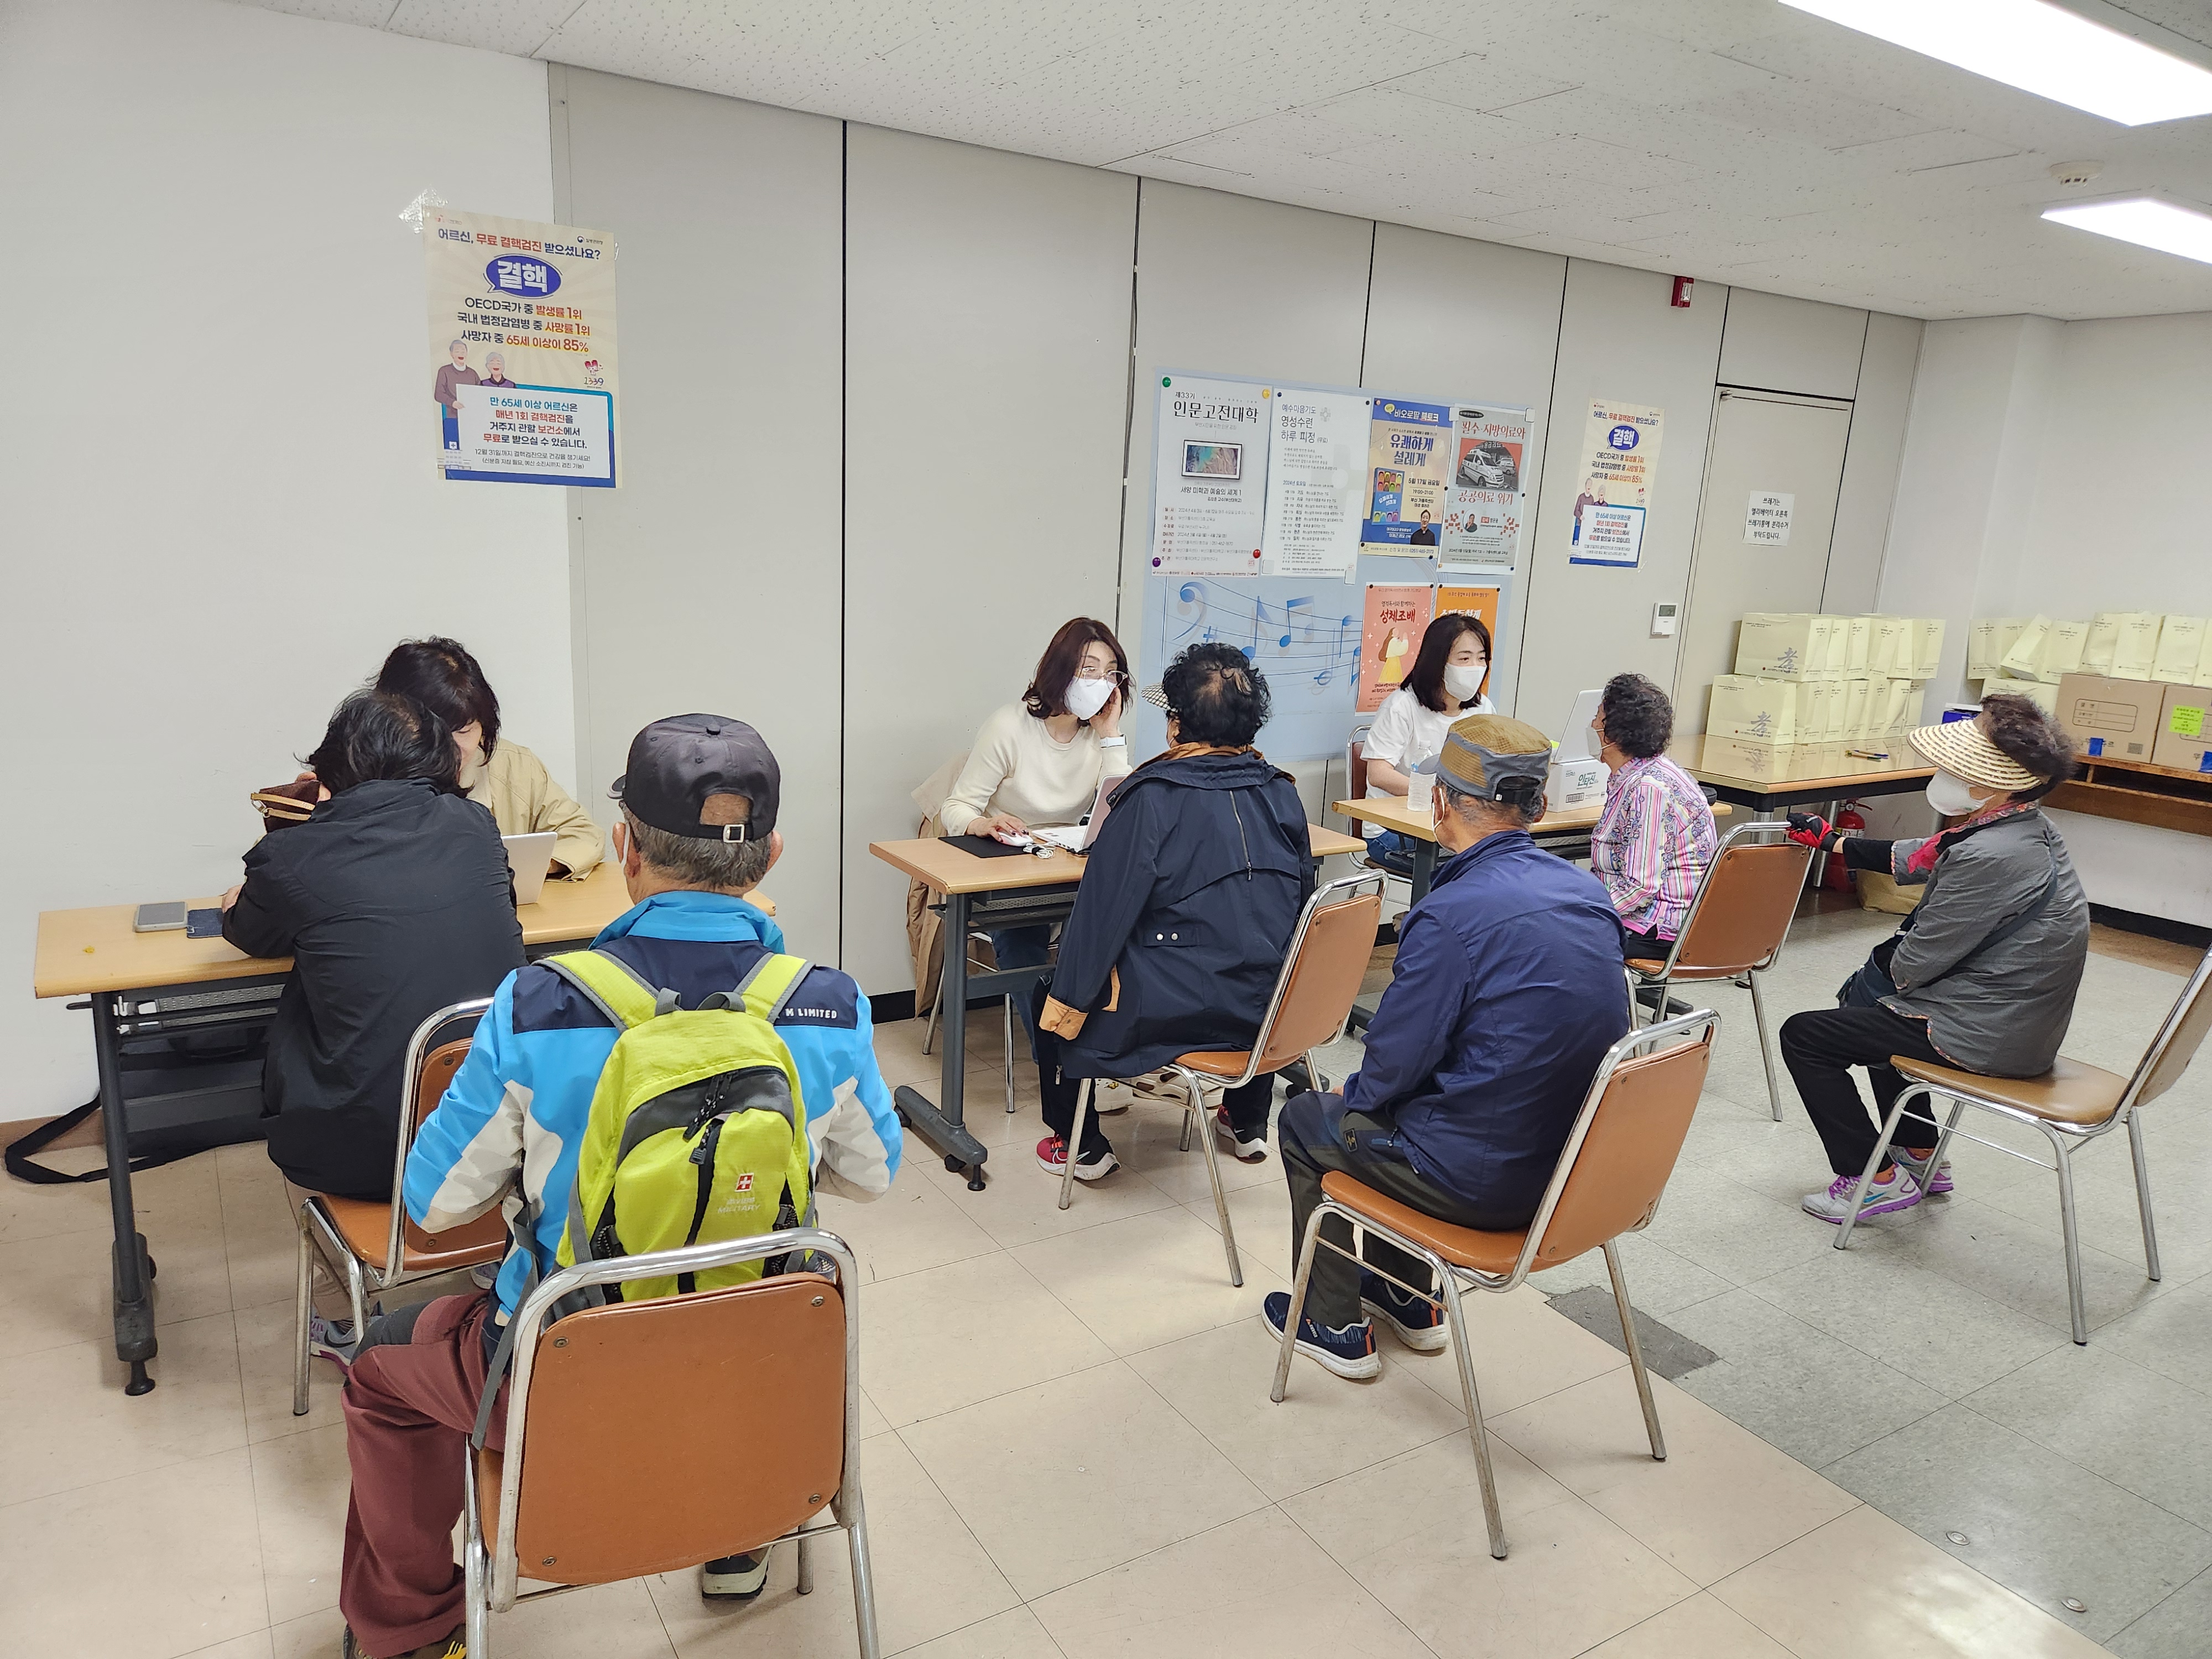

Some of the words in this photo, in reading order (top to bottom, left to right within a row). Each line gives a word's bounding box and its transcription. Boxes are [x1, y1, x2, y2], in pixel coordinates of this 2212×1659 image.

[439, 228, 473, 244] 어르신,
[476, 233, 498, 246] 무료
[500, 236, 541, 252] 결핵검진
[545, 242, 601, 260] 받으셨나요?
[498, 260, 547, 293] 결핵
[465, 298, 521, 313] OECD국가
[524, 304, 534, 315] 중
[536, 305, 565, 318] 발생률
[567, 307, 582, 320] 1위
[457, 312, 478, 324] 국내
[481, 315, 530, 330] 법정감염병
[533, 320, 542, 331] 중
[545, 322, 573, 334] 사망률
[575, 323, 590, 336] 1위
[461, 330, 492, 342] 사망자
[494, 333, 504, 343] 중
[507, 335, 529, 346] 65세
[533, 337, 561, 349] 이상이
[564, 338, 589, 352] 85%
[584, 377, 604, 386] 1339
[490, 397, 499, 406] 만
[501, 398, 522, 408] 65세
[524, 400, 541, 409] 이상
[544, 401, 578, 412] 어르신은
[1282, 404, 1316, 414] 예수마음기도
[495, 410, 513, 419] 매년
[515, 411, 528, 420] 1회
[530, 412, 573, 424] 결핵검진을
[1173, 400, 1259, 424] 인문고전대학
[1593, 410, 1608, 419] 어르신,
[1618, 414, 1635, 423] 결핵검진
[1636, 416, 1658, 426] 받으셨나요?
[490, 421, 516, 431] 거주지
[518, 424, 536, 433] 관할
[538, 425, 580, 436] 보건소에서
[1281, 415, 1313, 429] 영성수련
[483, 434, 510, 443] 무료로
[512, 435, 538, 445] 받으실
[540, 437, 549, 446] 수
[551, 438, 587, 448] 있습니다.
[1281, 430, 1297, 442] 하루
[1300, 431, 1316, 443] 피정
[1390, 434, 1434, 452] 유쾌하게
[1613, 429, 1635, 448] 결핵
[514, 451, 548, 459] 결핵검진으로
[567, 453, 591, 462] 챙기세요!
[1394, 451, 1426, 467] 설레게
[1601, 462, 1621, 471] 법정감염병
[1631, 475, 1642, 483] 85%
[1458, 490, 1494, 503] 공공의료
[1498, 492, 1514, 505] 위기
[1762, 497, 1780, 506] 쓰레기는
[1775, 509, 1788, 518] 오른쪽
[1747, 519, 1770, 528] 쓰레기통에
[1771, 521, 1789, 529] 분리수거
[1753, 531, 1781, 540] 부탁드립니다.
[1380, 609, 1416, 624] 성체조배
[1578, 773, 1596, 788] 인타신
[798, 1008, 837, 1019] LIMITED
[718, 1204, 760, 1213] MILITARY
